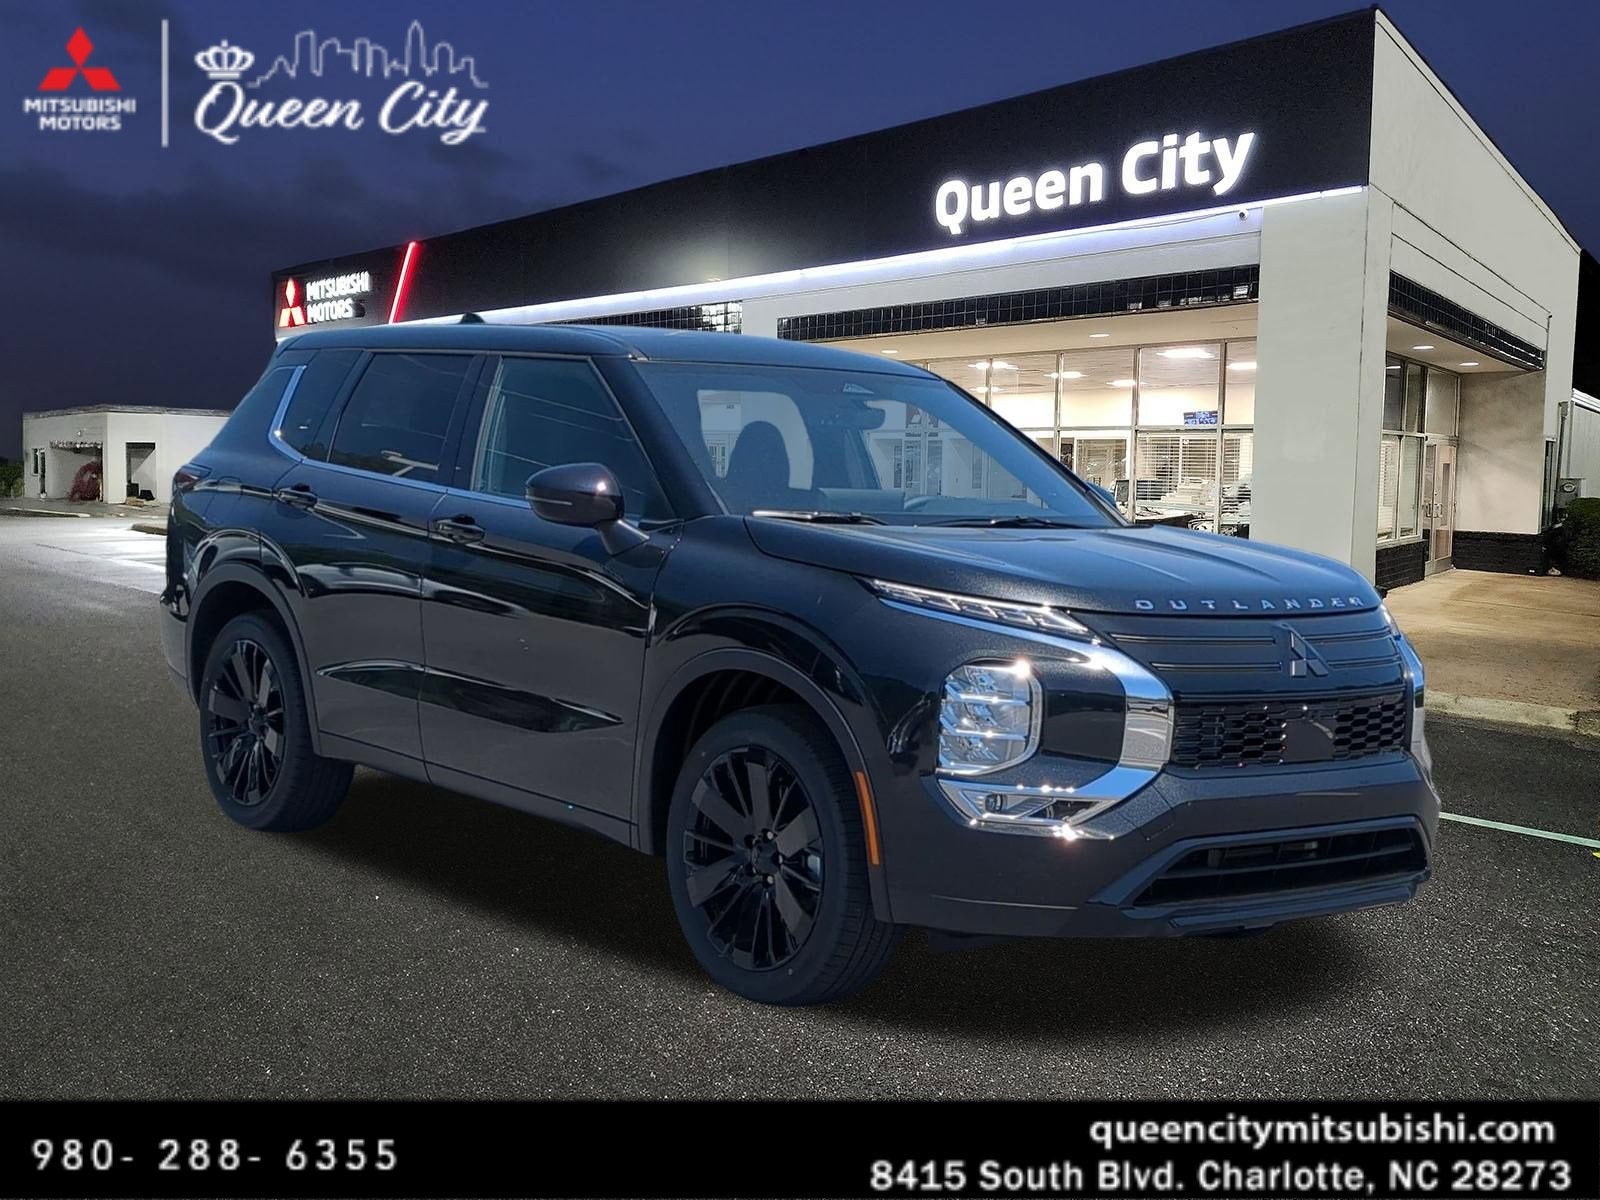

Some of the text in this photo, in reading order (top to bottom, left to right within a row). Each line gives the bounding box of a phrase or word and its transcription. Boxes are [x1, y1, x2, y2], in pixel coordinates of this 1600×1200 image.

[935, 131, 1256, 235] Queen City
[306, 271, 371, 302] MITSUBISHI
[306, 298, 355, 324] MOTORS
[1135, 596, 1365, 611] OUTLANDER
